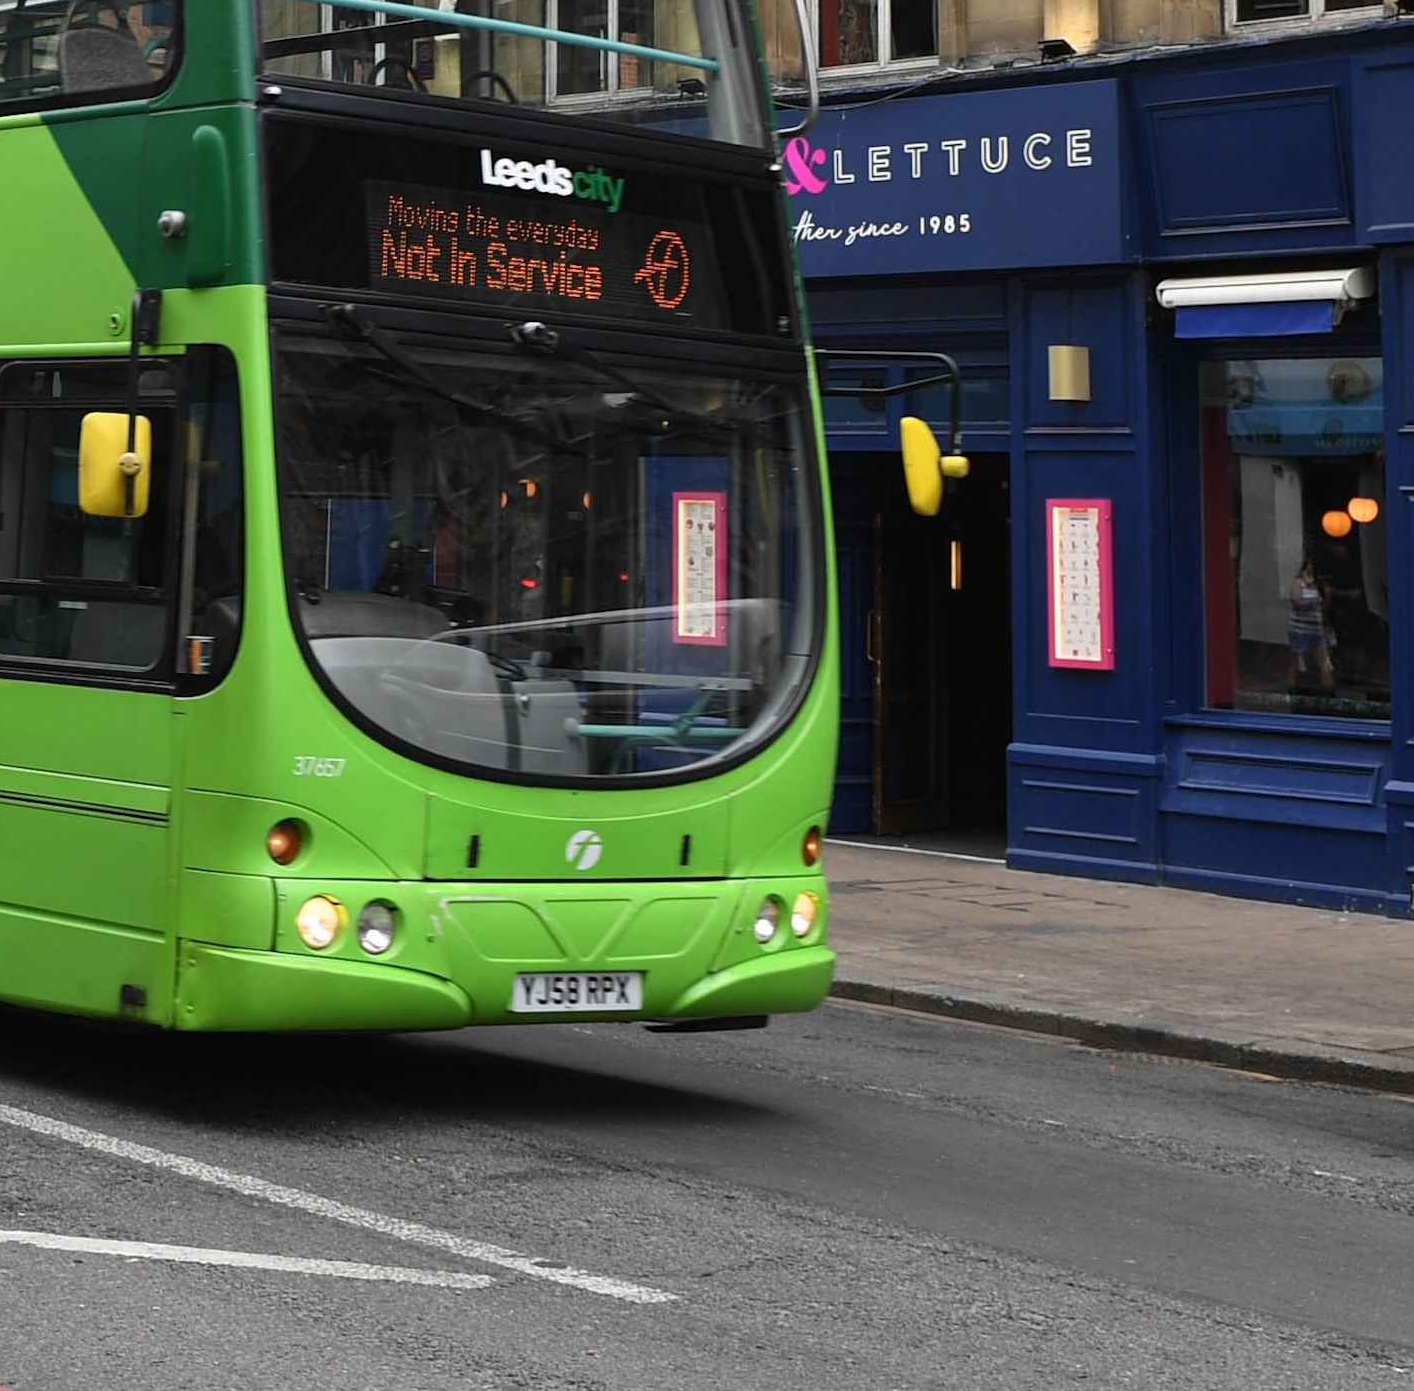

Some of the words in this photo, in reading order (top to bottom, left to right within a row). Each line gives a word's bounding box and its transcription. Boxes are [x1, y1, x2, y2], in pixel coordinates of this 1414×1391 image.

[388, 194, 459, 234] Moving
[466, 204, 500, 238] the
[506, 218, 600, 251] everyday
[845, 219, 909, 246] since
[920, 213, 971, 236] 1985
[381, 229, 441, 283] Not
[451, 236, 477, 287] In
[486, 240, 602, 301] Service
[521, 976, 579, 1006] YJ58
[586, 975, 630, 1005] RPX
